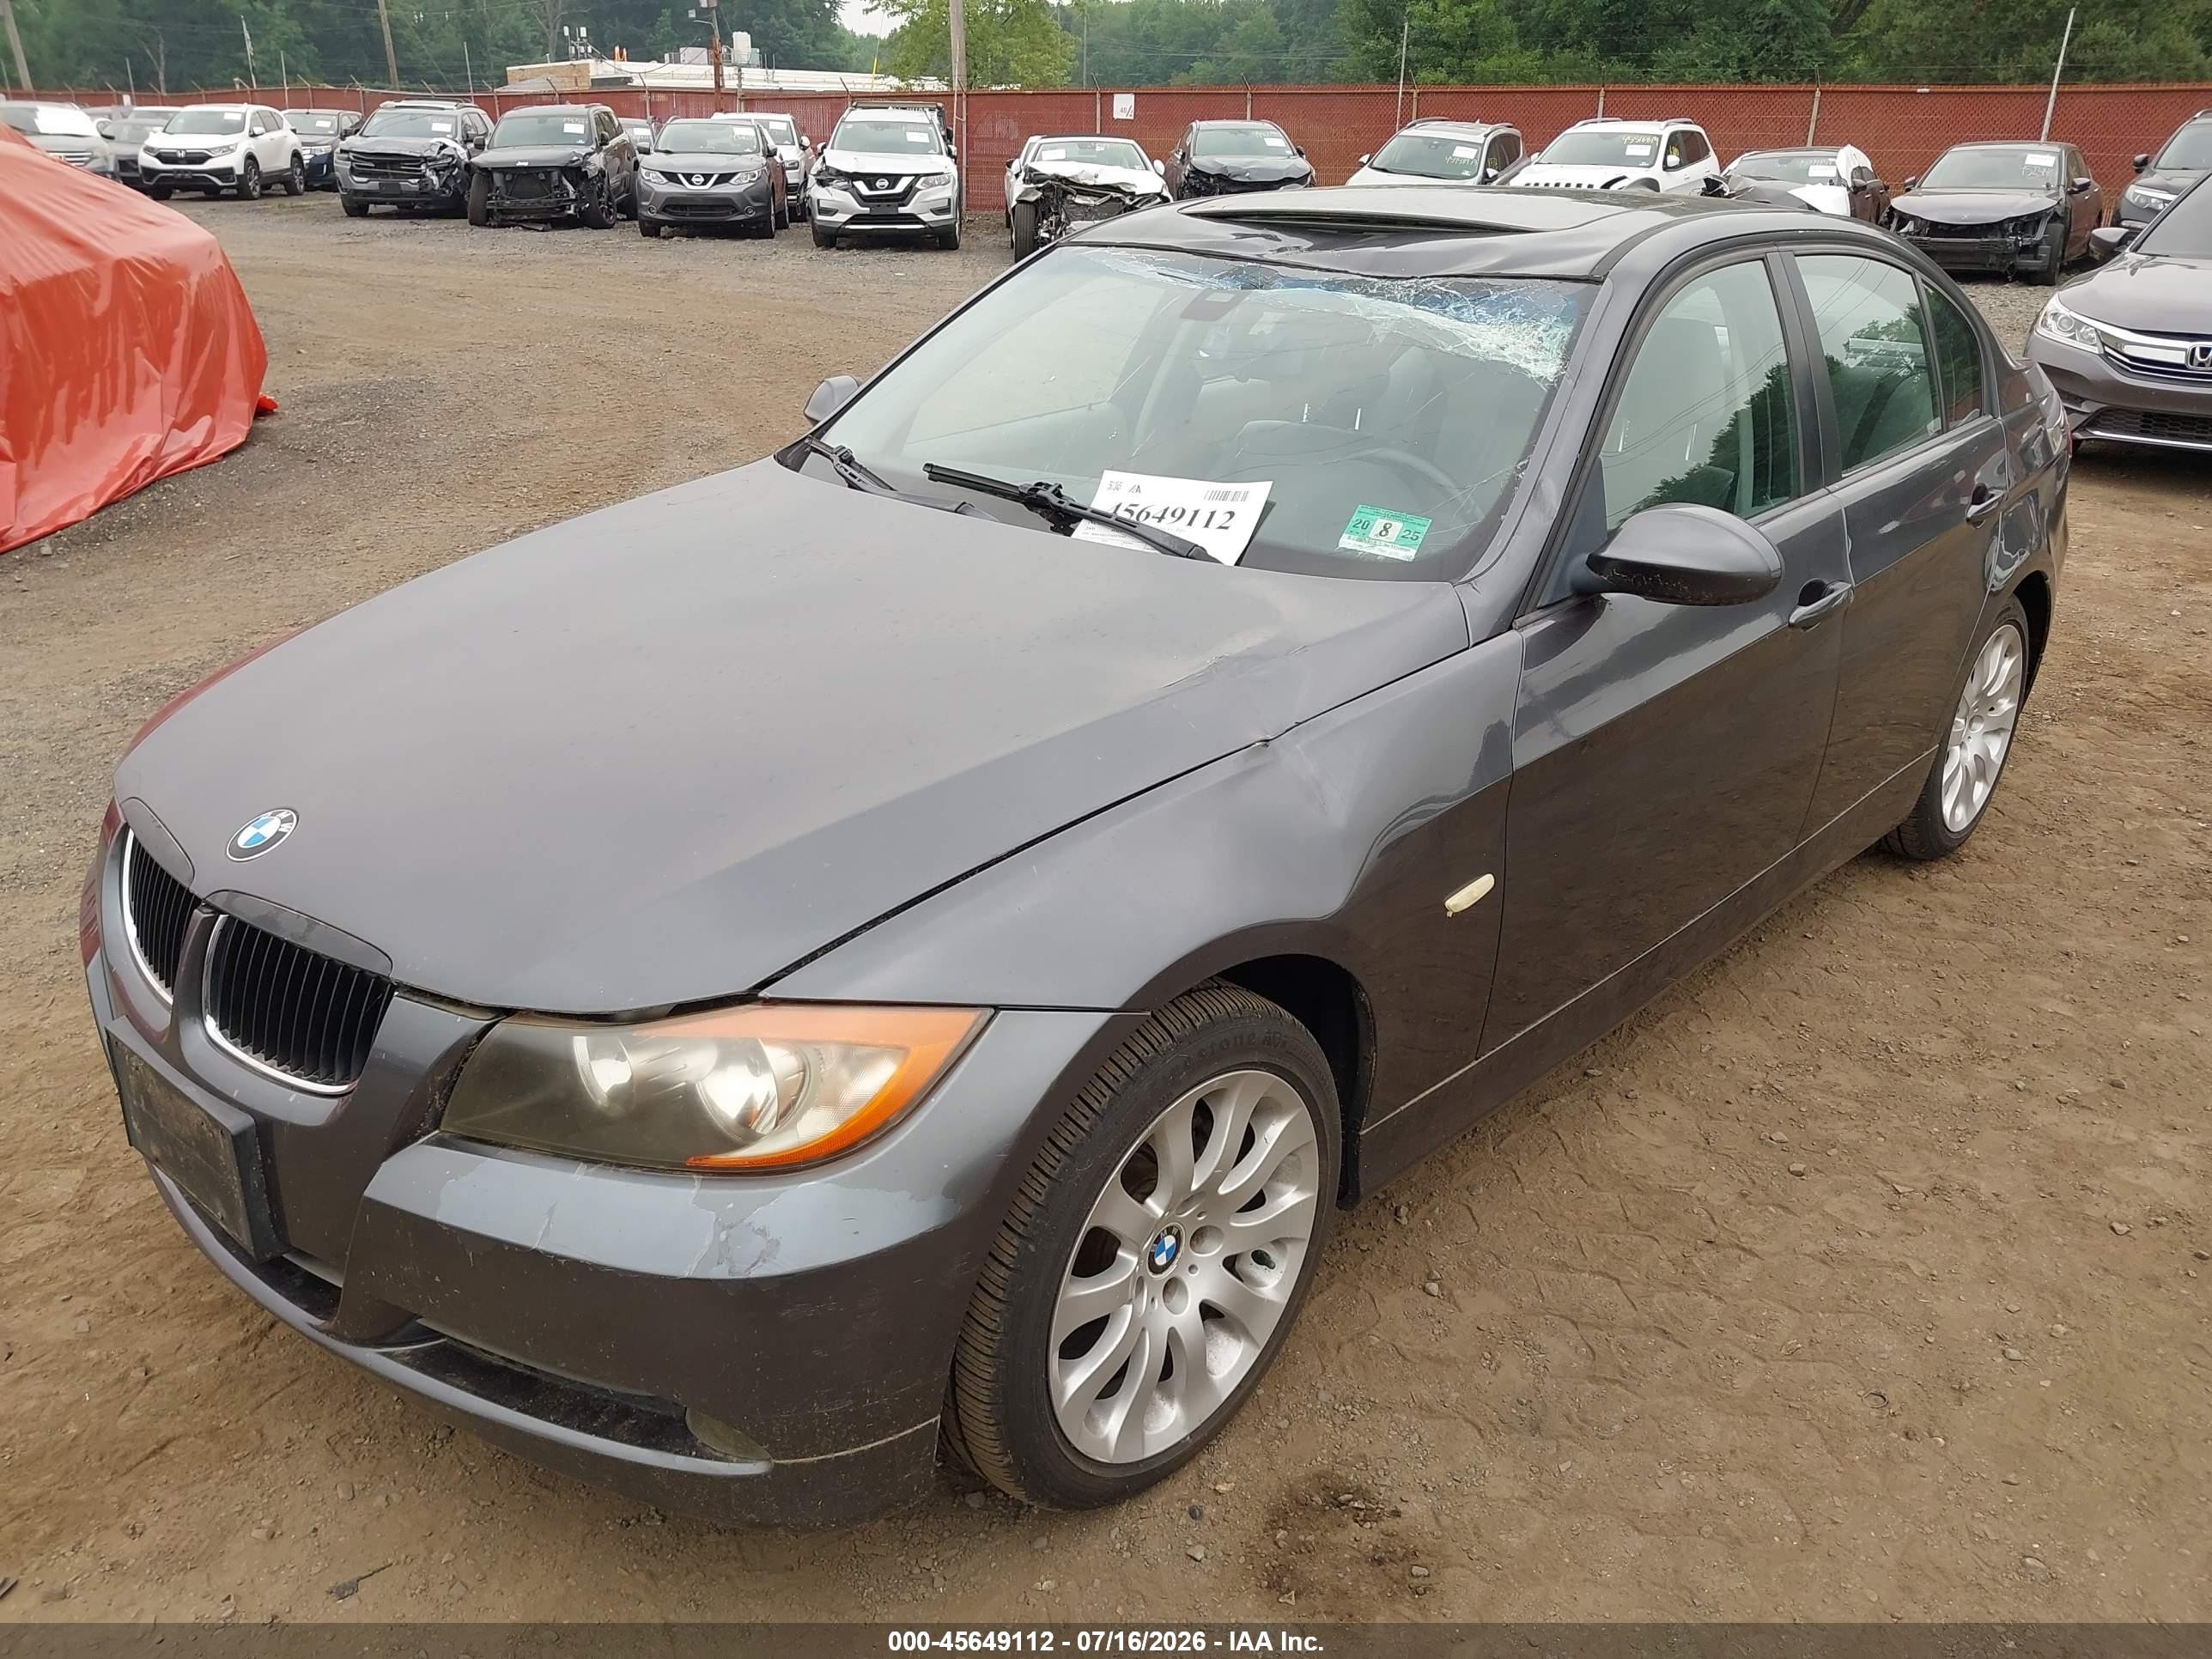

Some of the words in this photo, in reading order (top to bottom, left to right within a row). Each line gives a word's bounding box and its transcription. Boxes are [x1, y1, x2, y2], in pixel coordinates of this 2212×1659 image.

[1107, 501, 1236, 530] 45649112
[1352, 519, 1370, 530] 20
[1378, 522, 1393, 538] 8
[1401, 529, 1421, 541] 25
